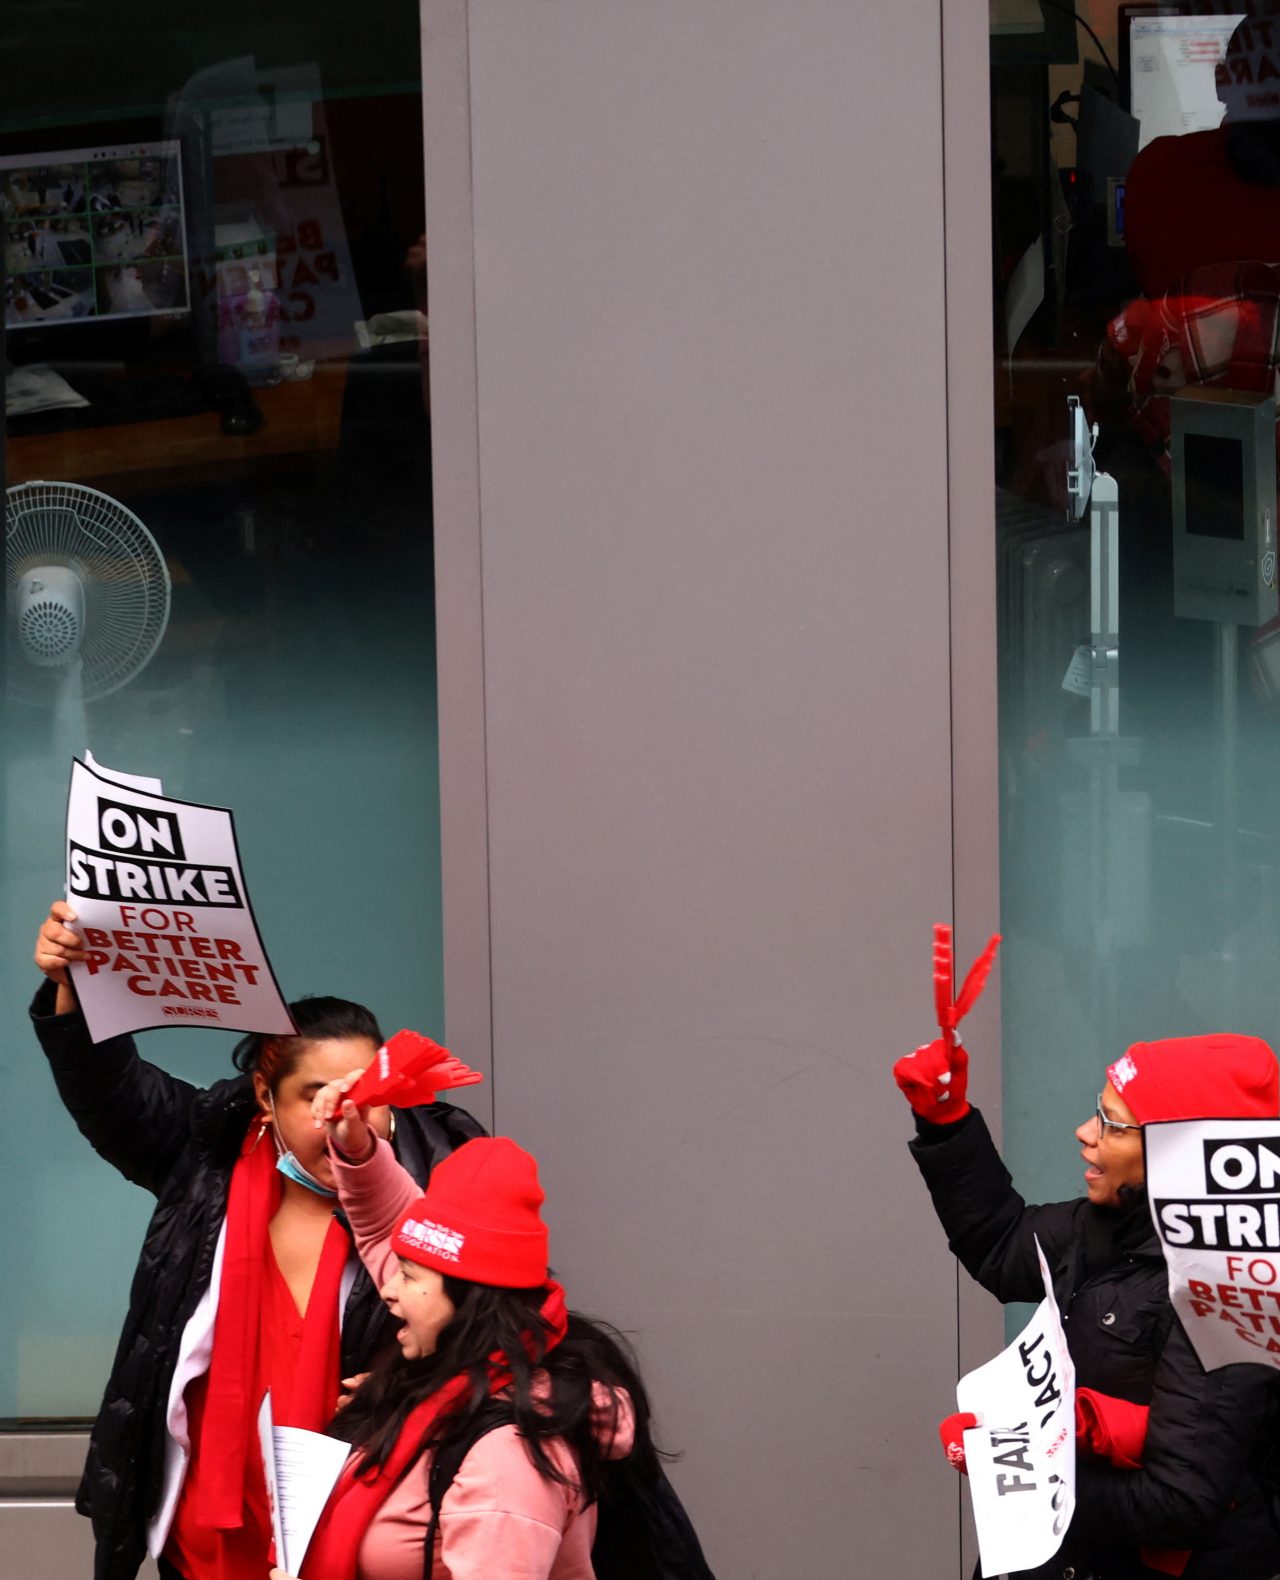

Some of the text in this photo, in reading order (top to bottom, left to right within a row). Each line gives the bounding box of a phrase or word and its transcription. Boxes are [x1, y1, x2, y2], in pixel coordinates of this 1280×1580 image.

[101, 807, 176, 854] ON
[71, 848, 237, 904] STRIKE
[119, 905, 197, 933] FOR
[83, 927, 246, 962] BETTER
[85, 950, 260, 986] PATIENT
[127, 975, 242, 1006] CARE
[989, 1421, 1037, 1497] FAIR
